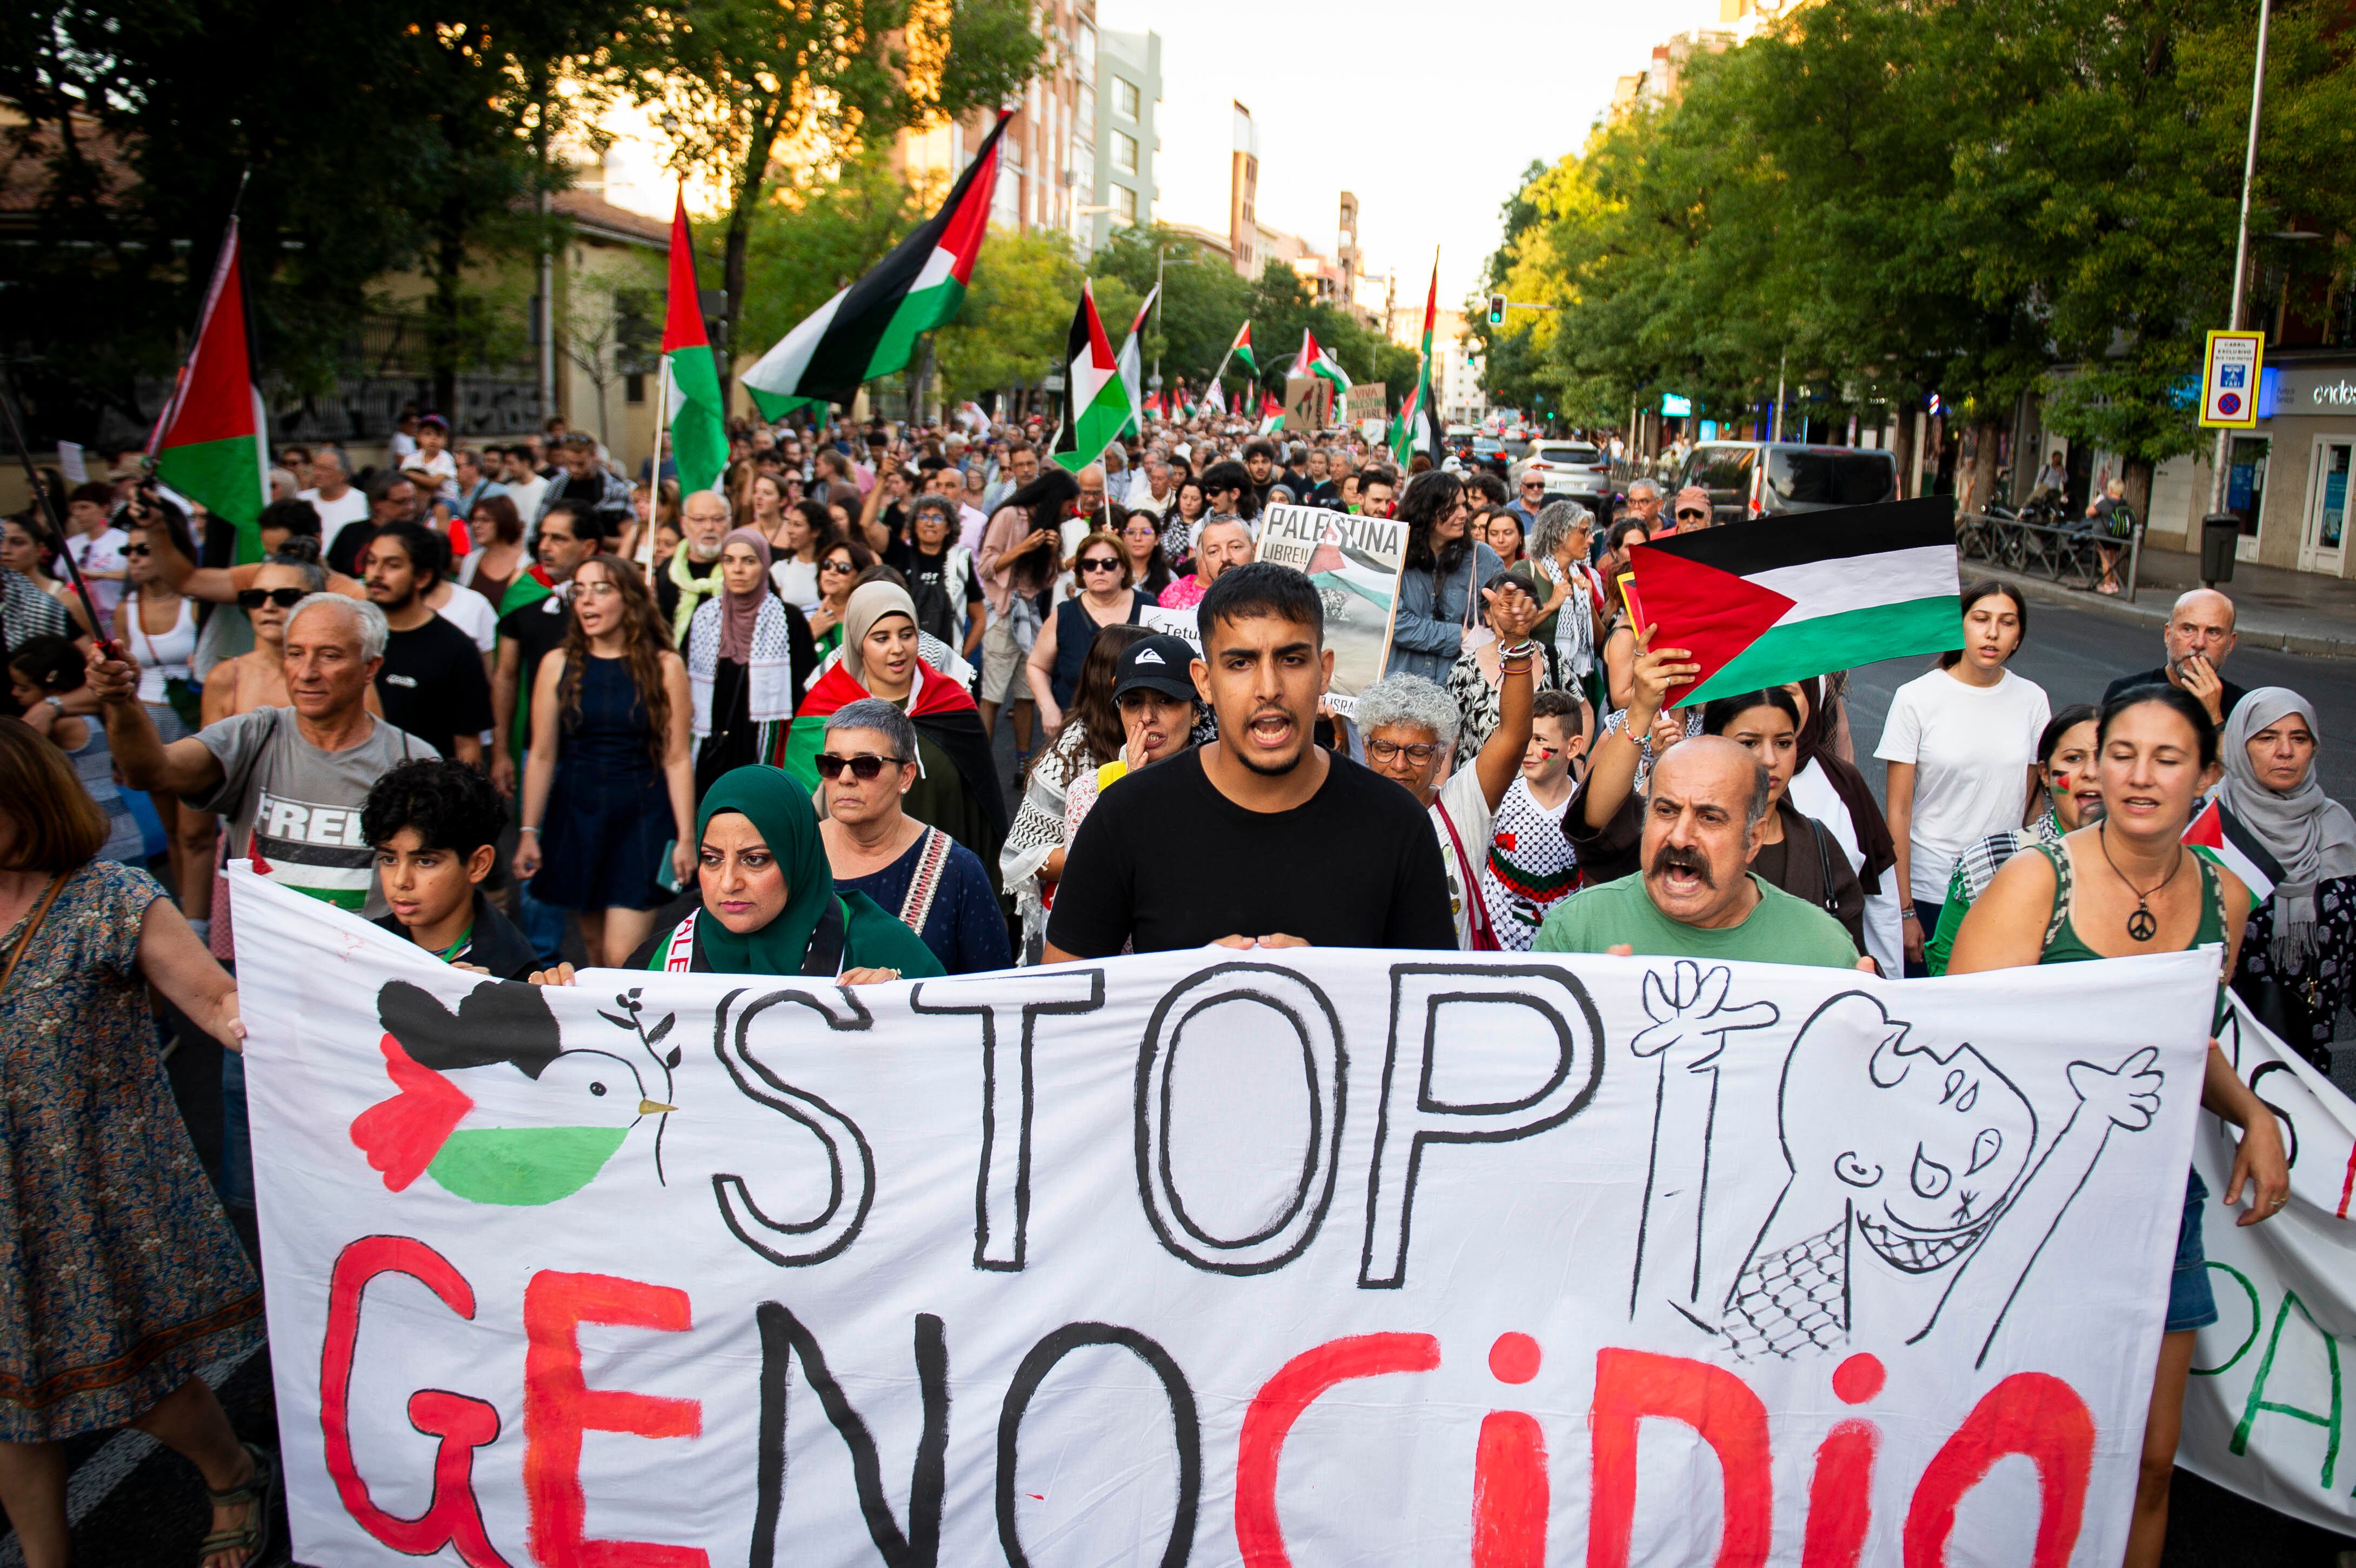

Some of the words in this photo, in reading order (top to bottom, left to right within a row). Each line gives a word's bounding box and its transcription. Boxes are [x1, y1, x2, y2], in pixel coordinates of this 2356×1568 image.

[1354, 388, 1378, 398] VIVA
[1348, 397, 1386, 410] PALESTINA
[1357, 409, 1381, 418] LIBRE
[1267, 507, 1398, 556] PALESTINA
[1263, 542, 1309, 564] LIBRE!!
[1164, 623, 1201, 640] Tetu
[711, 962, 1605, 1289] STOP
